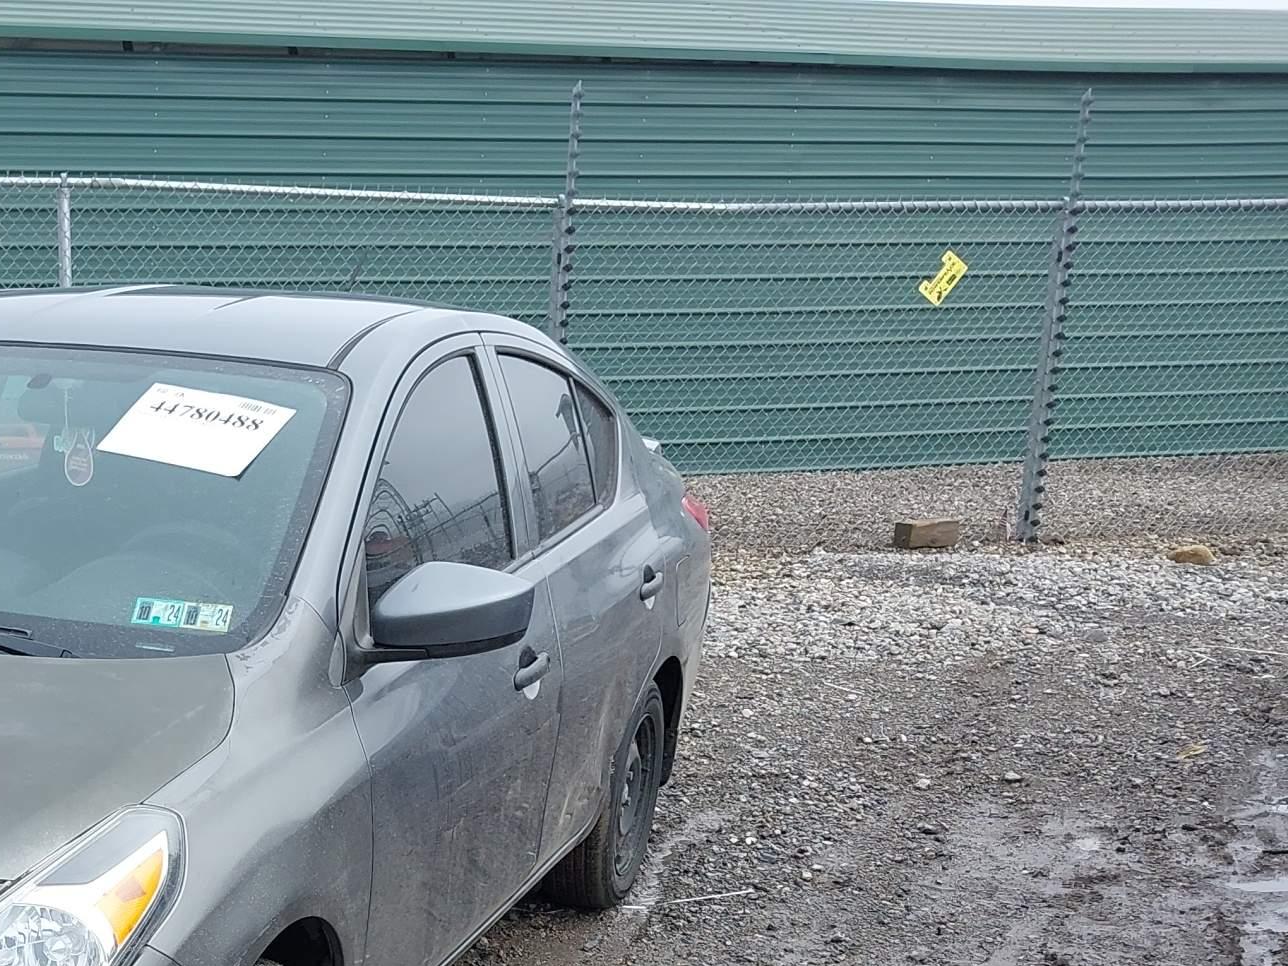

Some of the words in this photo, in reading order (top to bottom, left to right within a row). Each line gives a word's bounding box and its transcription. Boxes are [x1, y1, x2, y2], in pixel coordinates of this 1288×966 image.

[150, 400, 264, 431] 44780488
[167, 604, 181, 622] 24
[215, 608, 230, 626] 24
